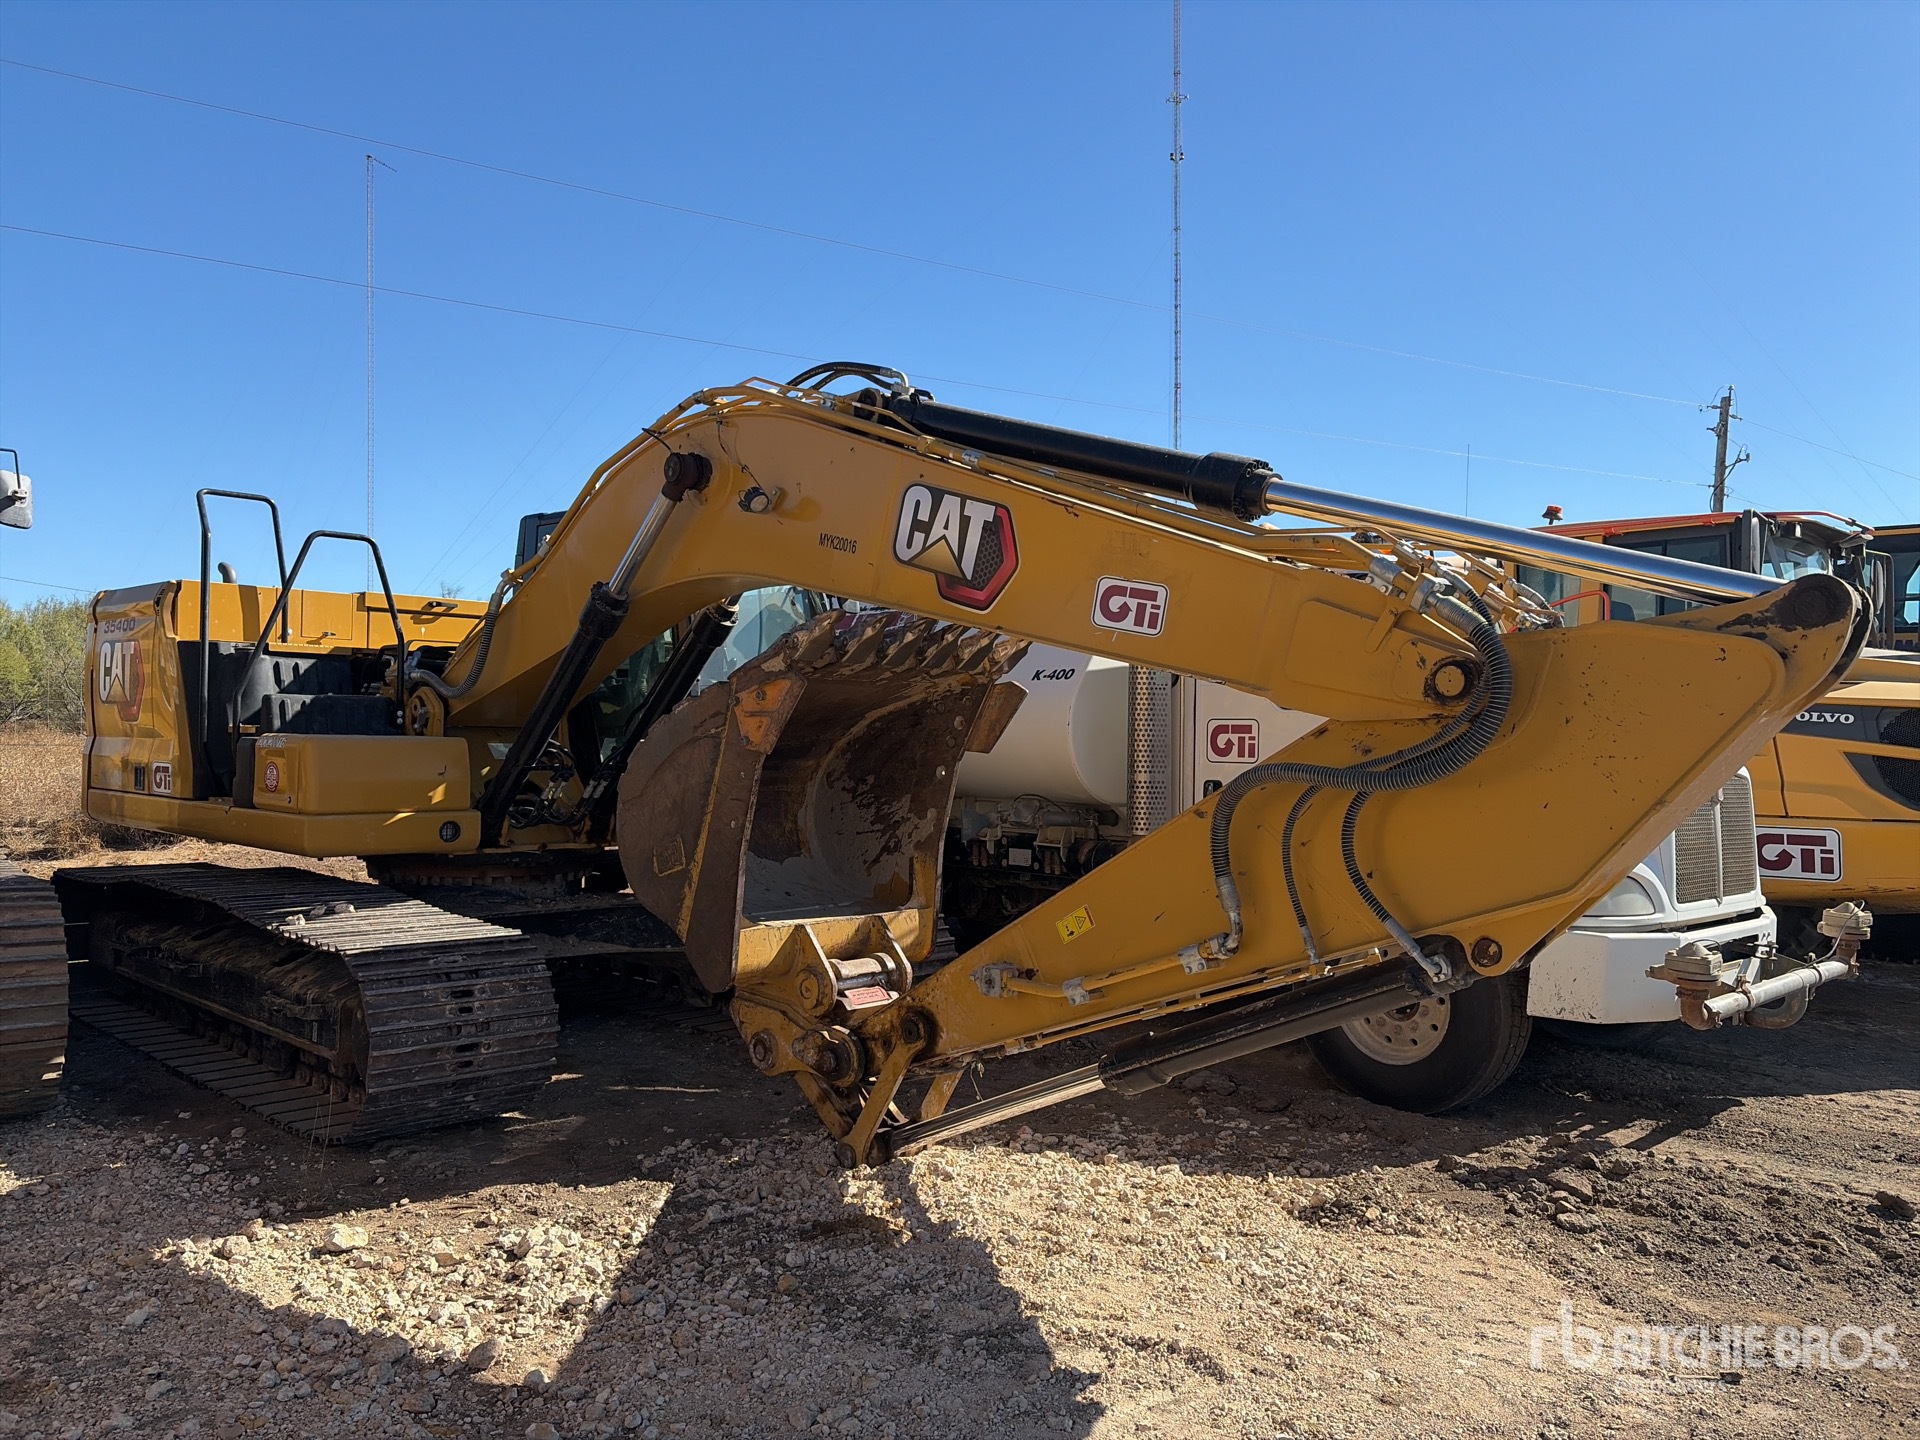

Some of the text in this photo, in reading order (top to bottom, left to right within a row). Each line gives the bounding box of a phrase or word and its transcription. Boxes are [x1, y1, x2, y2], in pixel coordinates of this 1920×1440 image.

[898, 486, 995, 580] CAT
[818, 532, 857, 554] MYK20016
[103, 618, 136, 634] 35400
[99, 641, 135, 703] CAT
[1031, 668, 1076, 682] K-400
[1795, 711, 1855, 725] OLVO
